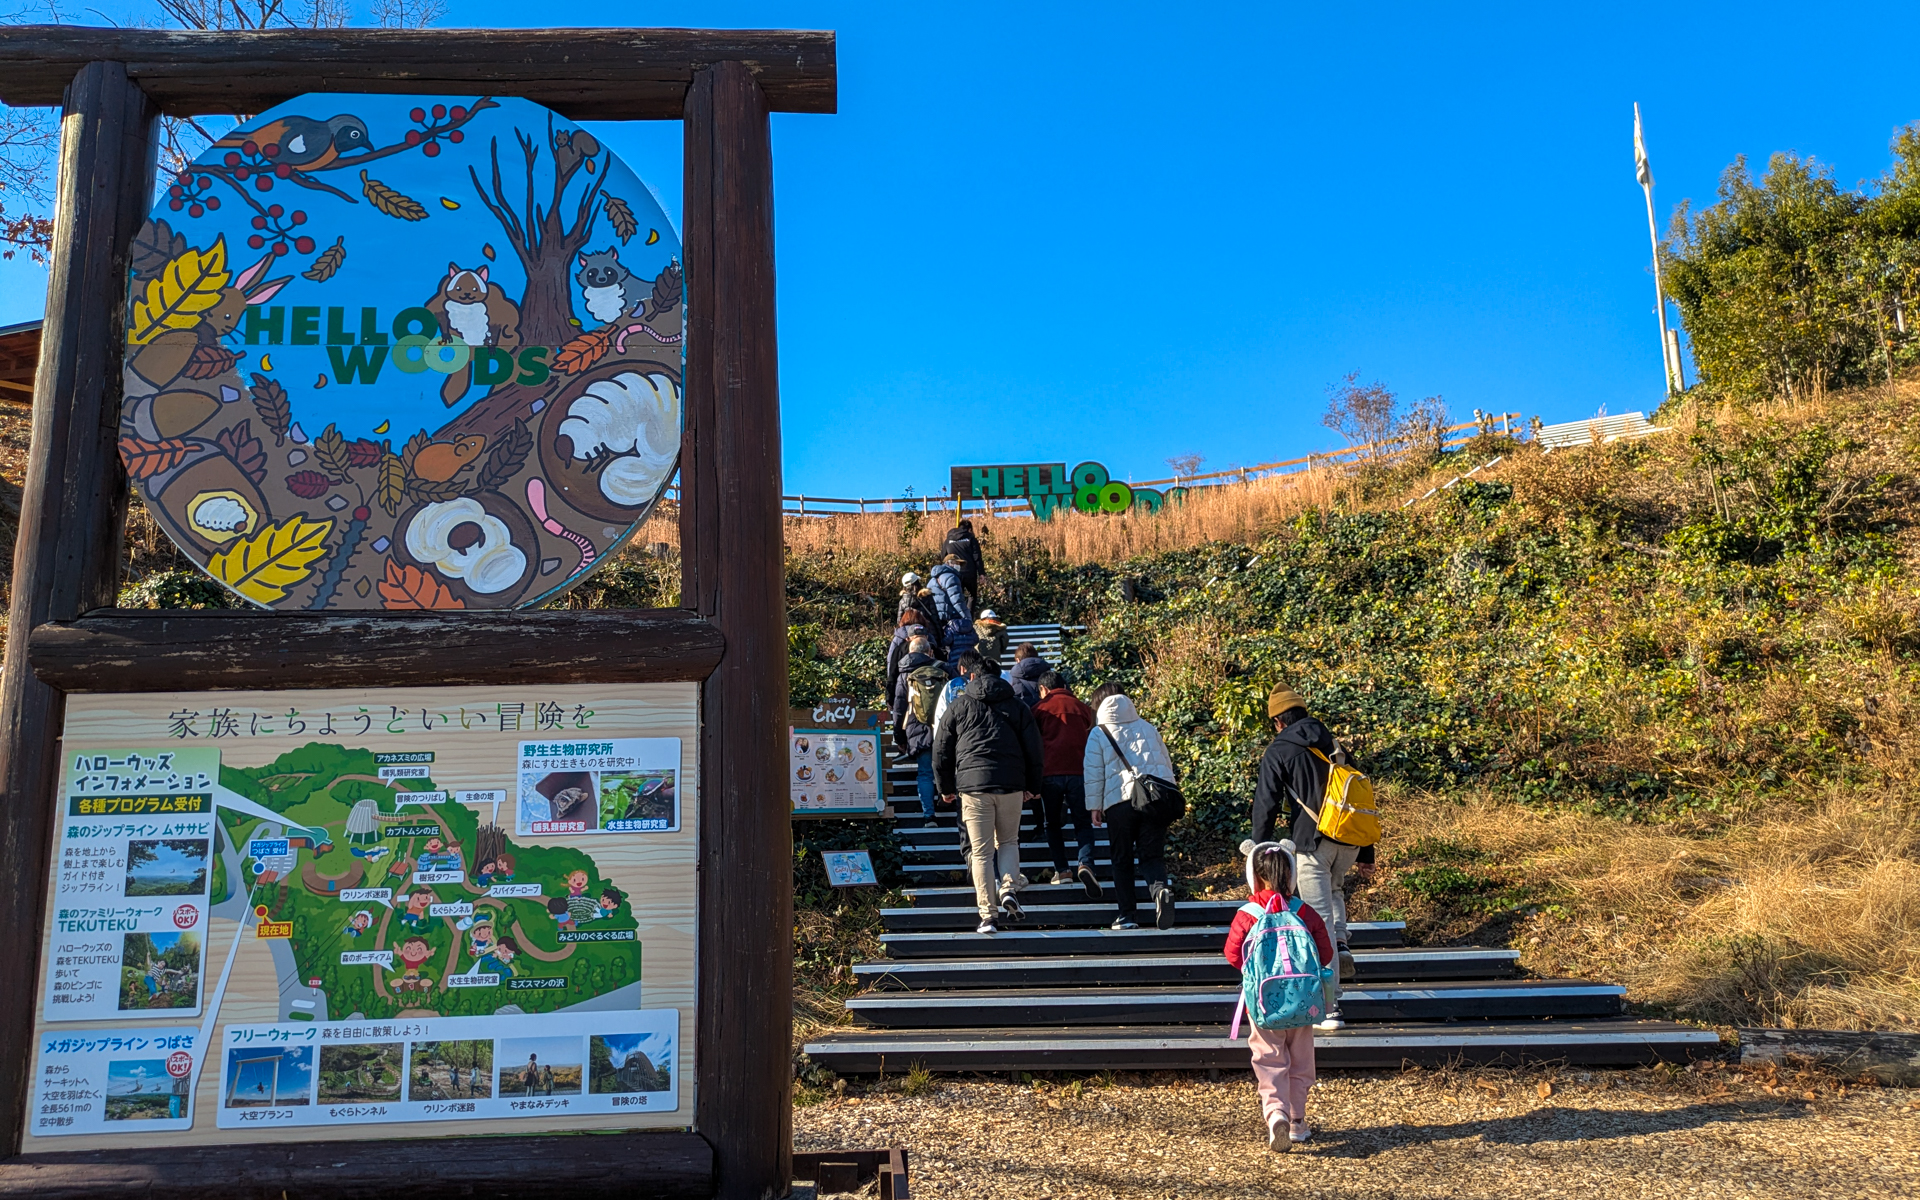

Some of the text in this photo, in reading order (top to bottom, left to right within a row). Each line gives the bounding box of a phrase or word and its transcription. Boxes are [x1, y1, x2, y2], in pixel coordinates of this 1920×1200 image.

[245, 306, 439, 346] HELLO
[325, 334, 549, 387] WOODS
[971, 463, 1108, 497] HELLO
[167, 700, 596, 739] 家族にちょうどいい冒険を
[523, 742, 614, 757] 野生生物研究所
[75, 753, 175, 772] ハローウッズ
[377, 753, 432, 763] アカネズミの広場
[75, 773, 211, 792] インフォメーション
[396, 793, 445, 803] 冒険のつりばし
[465, 792, 495, 801] 生命の塔
[79, 796, 203, 814] 各種プログラム受付
[66, 822, 211, 839] 森のジップライン ムササビ
[607, 819, 668, 830] 水生生物研究室
[386, 826, 440, 836] カブトムシの丘
[64, 846, 117, 857] 森を地上から
[63, 858, 125, 869] 樹上まで楽しむ
[62, 871, 106, 881] ガイド付き
[419, 873, 458, 882] 樹冠タワー
[492, 885, 540, 896] スパイダーロープ
[58, 906, 164, 920] 森のファミリーウォーク
[431, 906, 471, 915] もぐらトンネル
[58, 918, 138, 933] TEKUTEKU
[177, 915, 194, 924] OK!
[260, 924, 290, 936] 現在地
[558, 930, 635, 943] みどりのぐるぐる広場
[57, 942, 114, 953] ハローウッズの
[56, 954, 121, 966] 森をTEKUTEKU
[54, 968, 81, 979] 歩いて
[53, 980, 103, 991] 森のビンゴに
[449, 975, 498, 986] 水生生物研究室
[510, 978, 565, 989] ミズスマシの沢
[230, 1027, 318, 1043] フリーウォーク
[45, 1035, 195, 1054] メガジップライン つばさ
[44, 1064, 70, 1076] 森から
[171, 1062, 188, 1072] OK!
[43, 1077, 90, 1088] サーキットへ
[509, 1098, 571, 1111] やまなみデッキ
[611, 1095, 649, 1107] 冒険の塔
[40, 1103, 92, 1115] 全長561mの
[328, 1106, 389, 1118] もぐらトンネル
[423, 1102, 476, 1114] ウリンボ迷路
[239, 1109, 295, 1121] 大空ブランコ
[39, 1116, 75, 1128] 空中散歩
